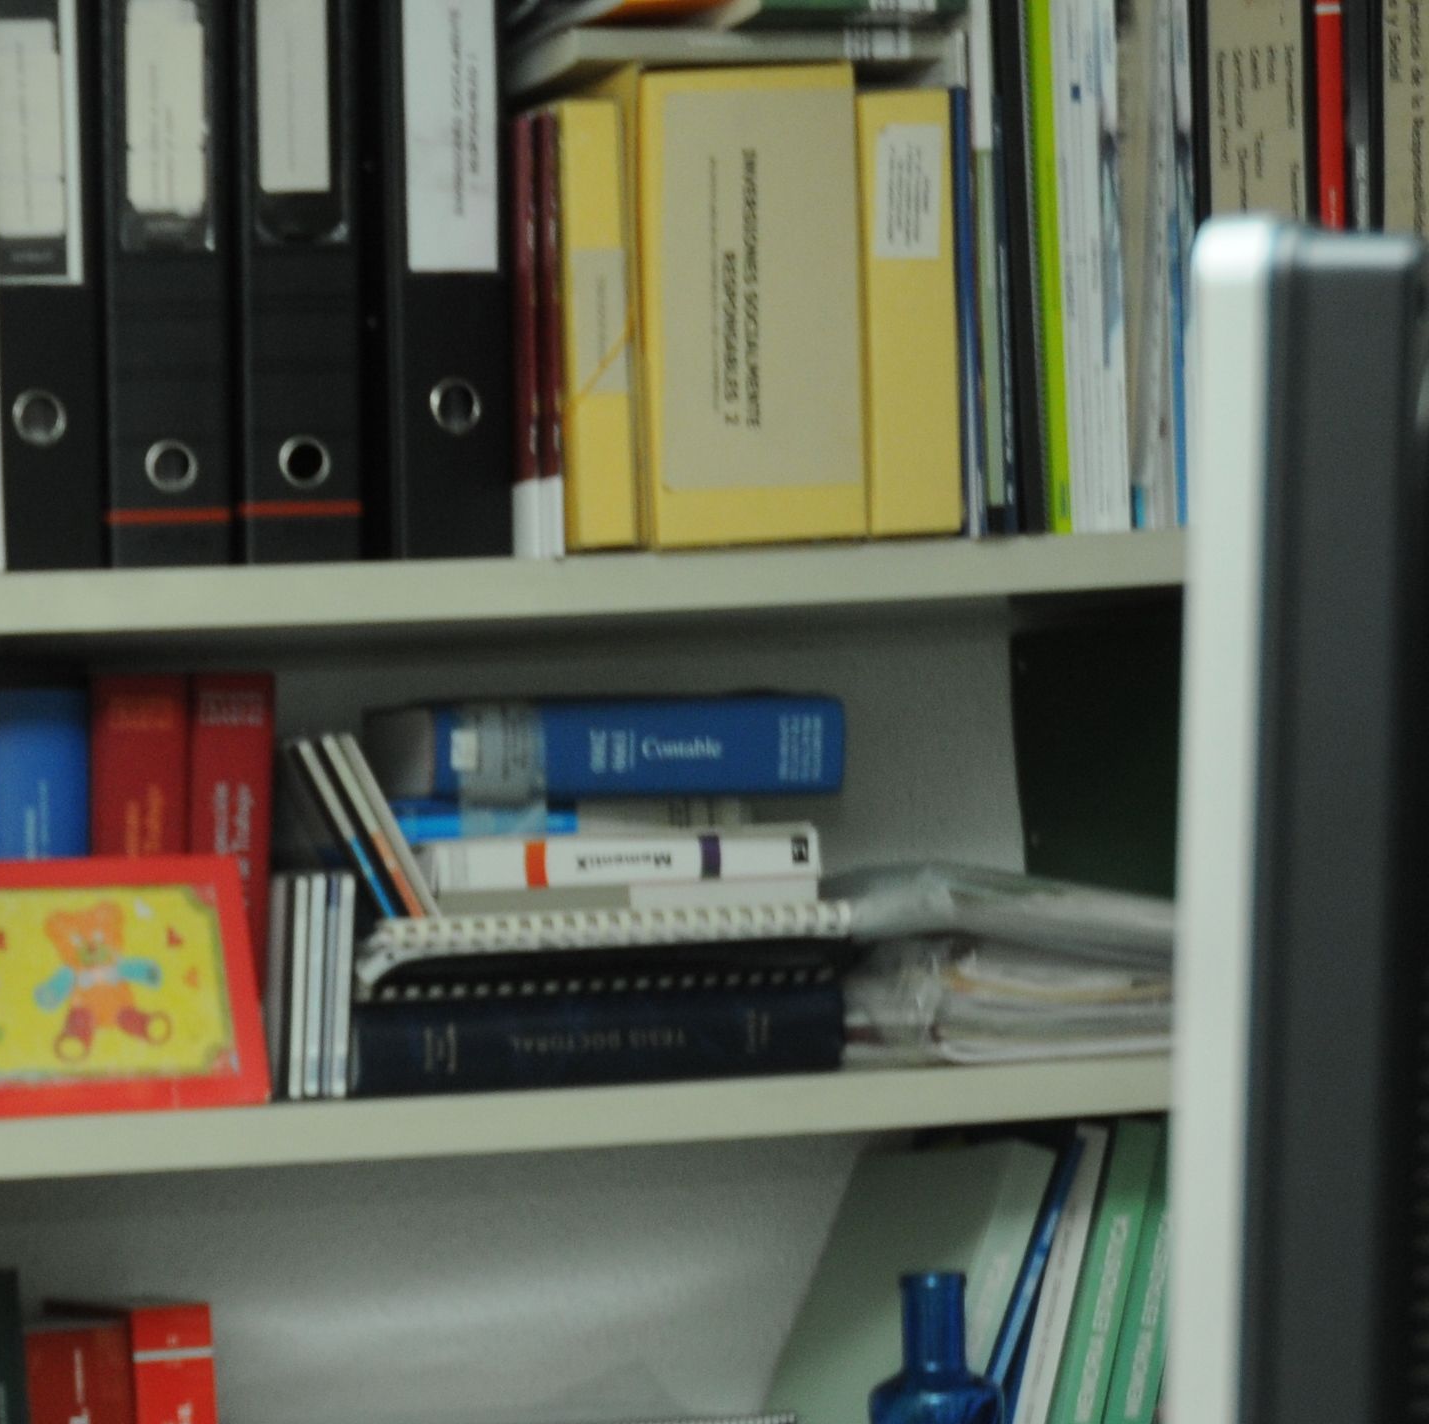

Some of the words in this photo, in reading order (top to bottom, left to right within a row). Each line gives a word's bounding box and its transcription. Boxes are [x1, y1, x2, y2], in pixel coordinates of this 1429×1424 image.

[741, 148, 756, 284] INVERSIONES
[722, 250, 738, 402] RESPONSABLES
[743, 290, 760, 429] SOCIALMENTE
